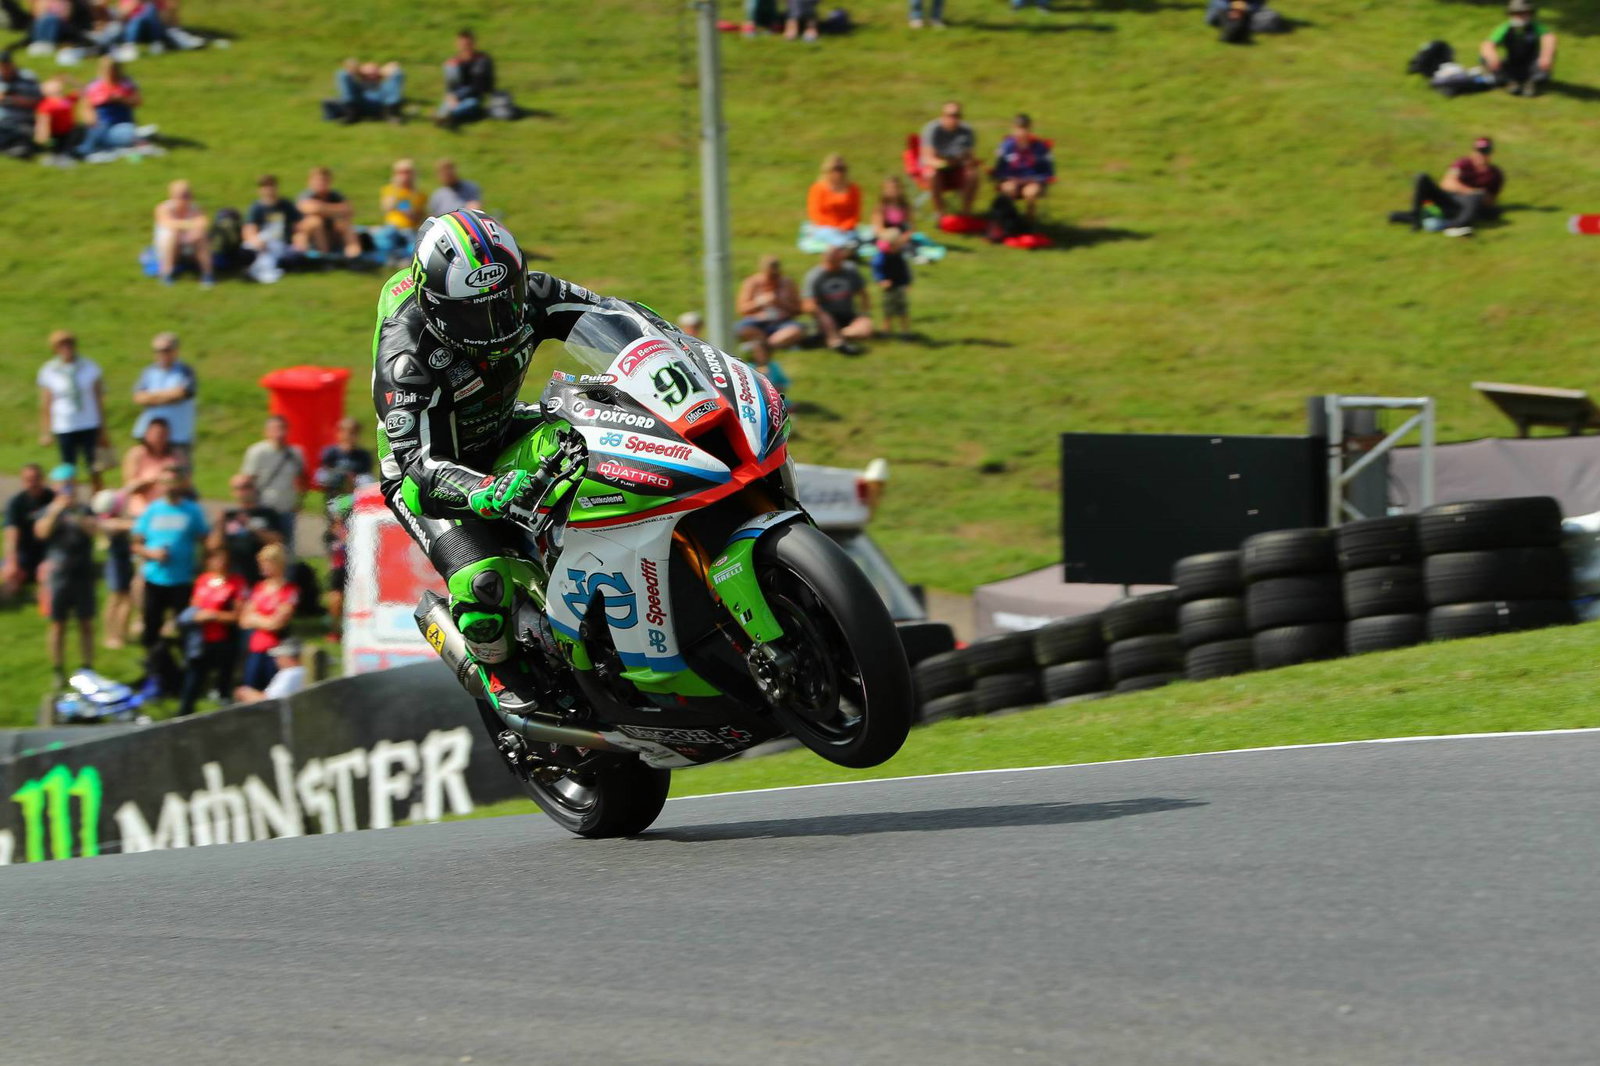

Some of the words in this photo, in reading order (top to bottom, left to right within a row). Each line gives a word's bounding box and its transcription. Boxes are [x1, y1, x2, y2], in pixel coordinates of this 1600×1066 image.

[472, 267, 504, 283] Arai
[463, 338, 488, 346] Derby
[580, 374, 609, 384] Puig
[649, 360, 707, 412] 91
[387, 415, 406, 430] R&G
[600, 410, 656, 429] OXFORD
[625, 436, 692, 461] Speedfit
[600, 464, 669, 487] QUATTRO
[620, 480, 636, 488] PLANT
[713, 562, 743, 586] PIRELLI
[641, 557, 667, 627] Speedfit
[113, 727, 473, 855] MONSTER
